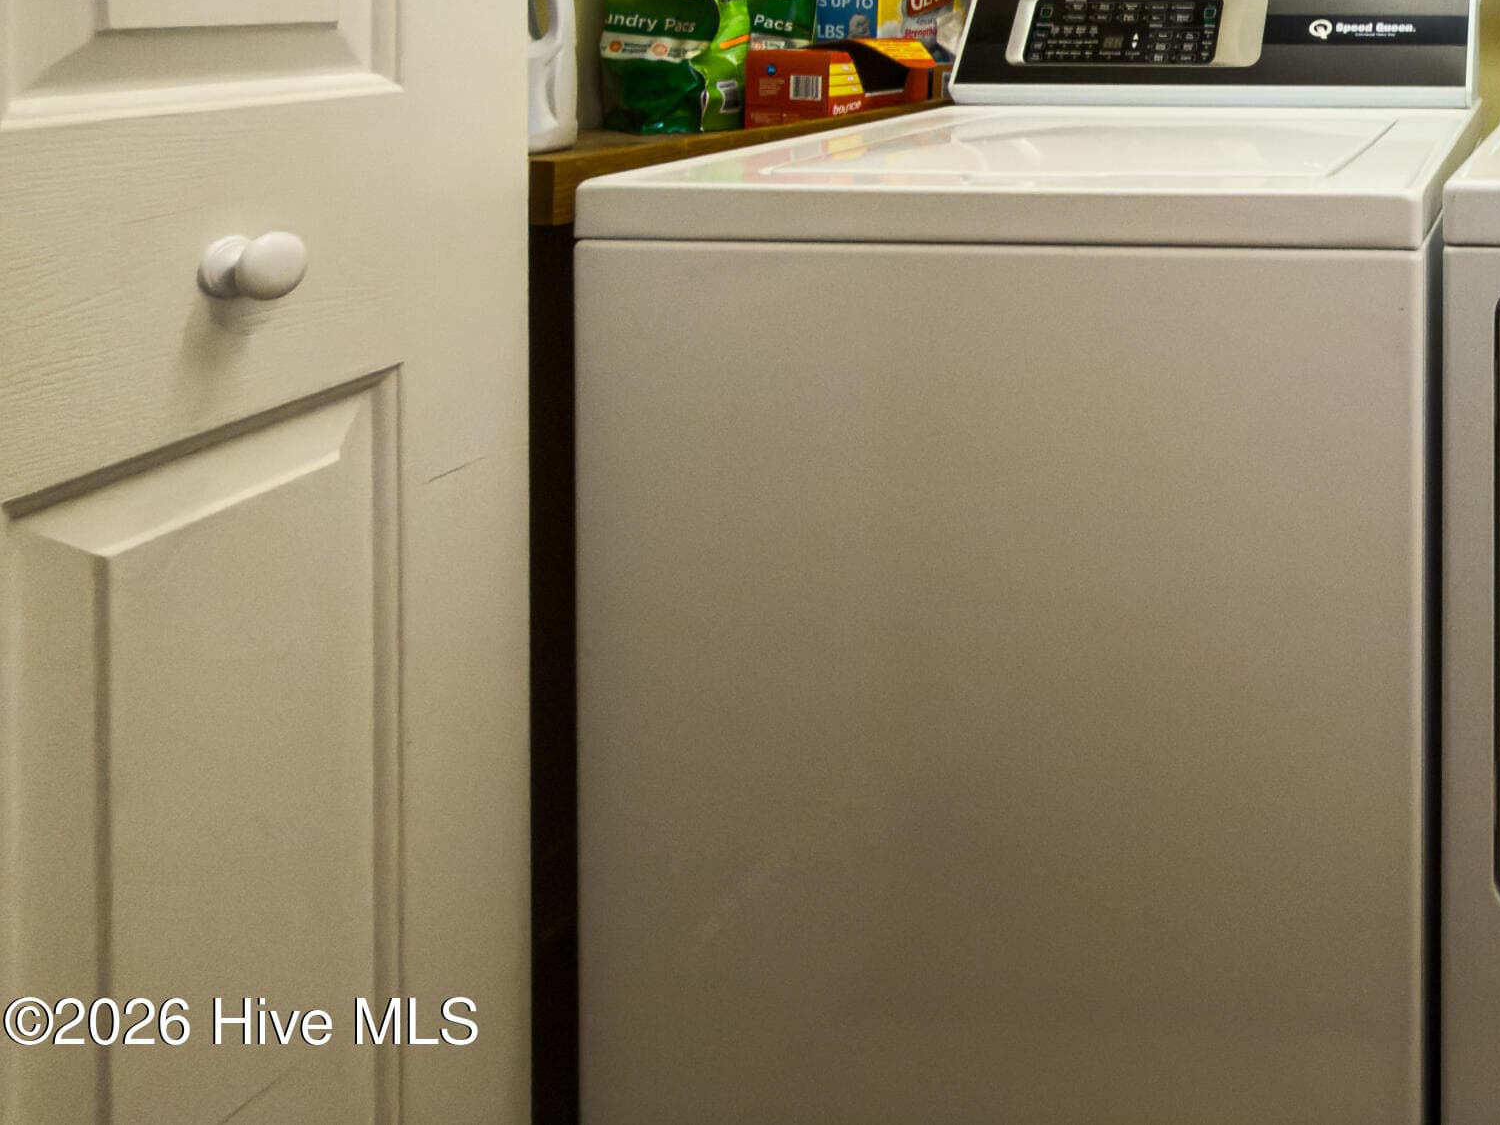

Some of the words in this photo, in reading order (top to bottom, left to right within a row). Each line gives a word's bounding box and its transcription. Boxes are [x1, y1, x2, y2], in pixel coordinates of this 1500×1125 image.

[664, 17, 697, 34] Pacs
[753, 13, 794, 33] Pacs
[1335, 21, 1374, 34] Speed
[817, 24, 846, 40] LBS
[832, 99, 863, 115] bounce
